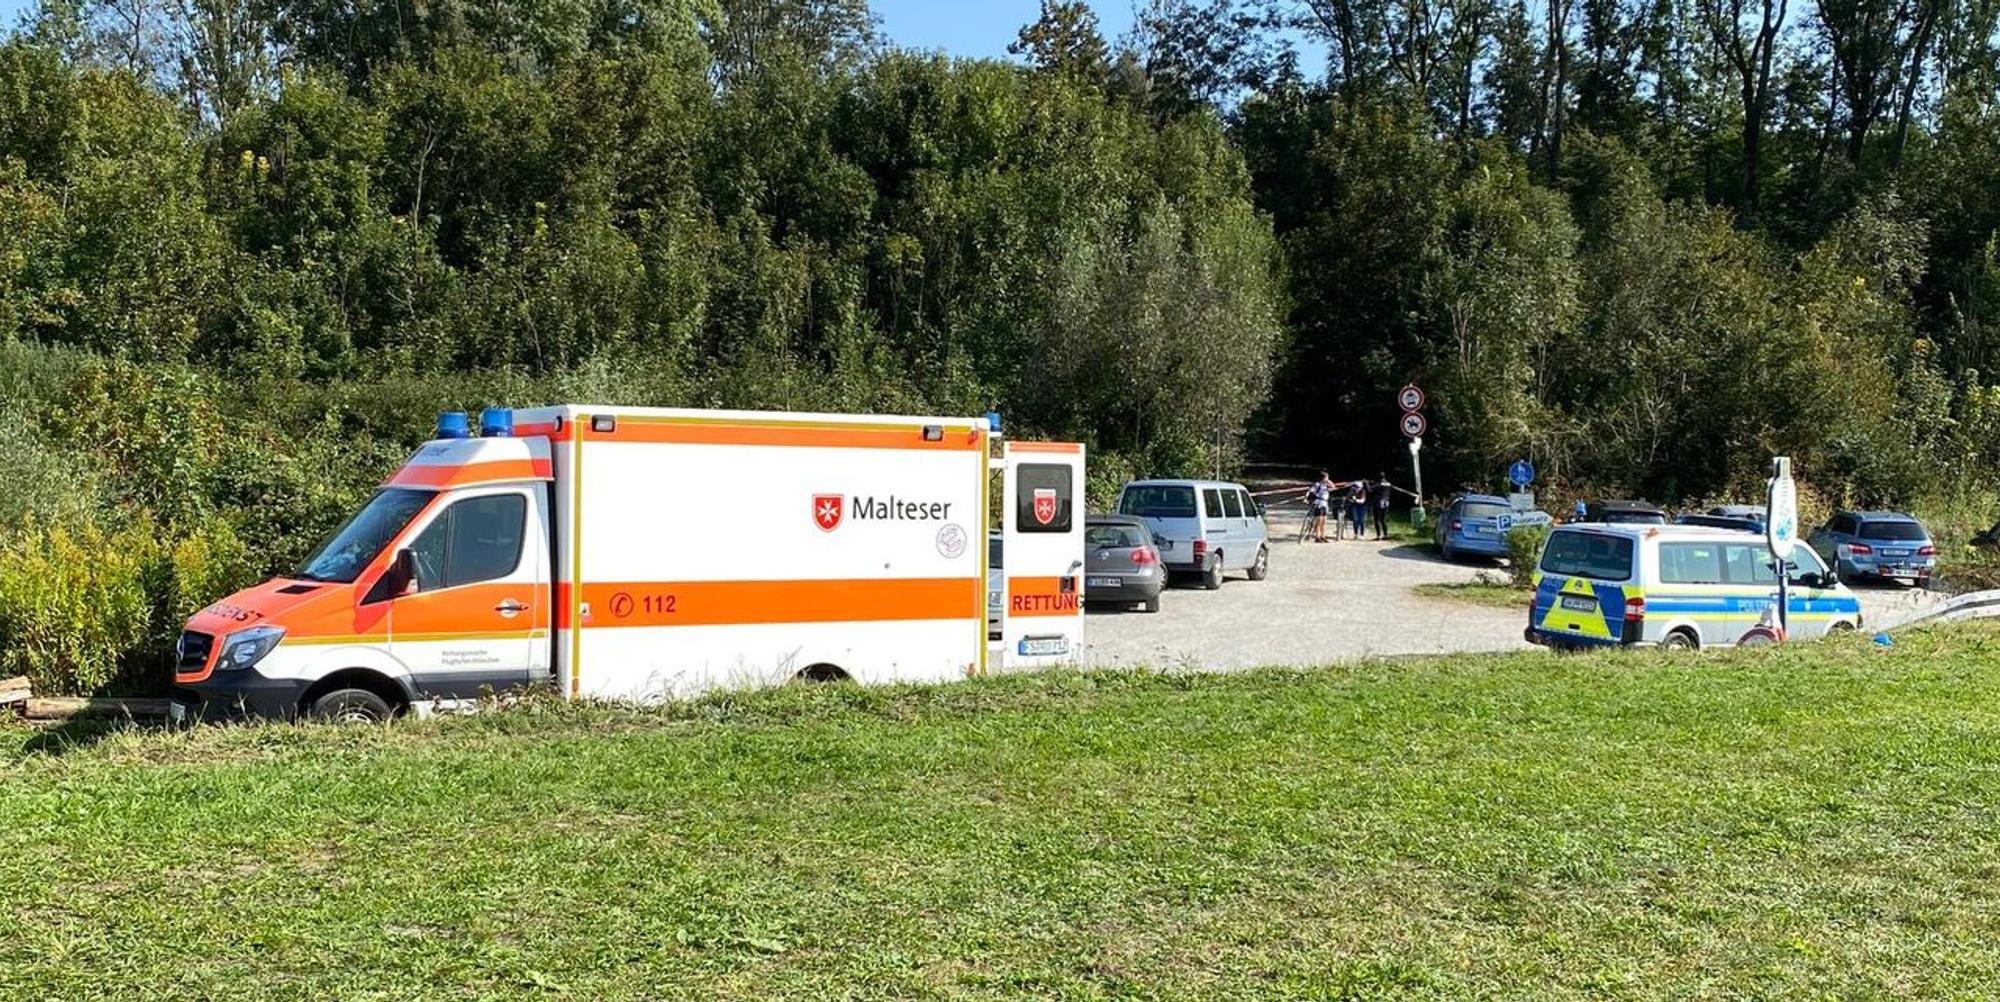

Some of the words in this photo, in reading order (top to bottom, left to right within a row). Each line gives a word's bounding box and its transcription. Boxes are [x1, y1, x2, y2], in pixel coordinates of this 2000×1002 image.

[853, 495, 952, 520] Malteser
[1501, 517, 1510, 529] P
[643, 595, 676, 613] 112
[1012, 594, 1087, 612] RETTUNG
